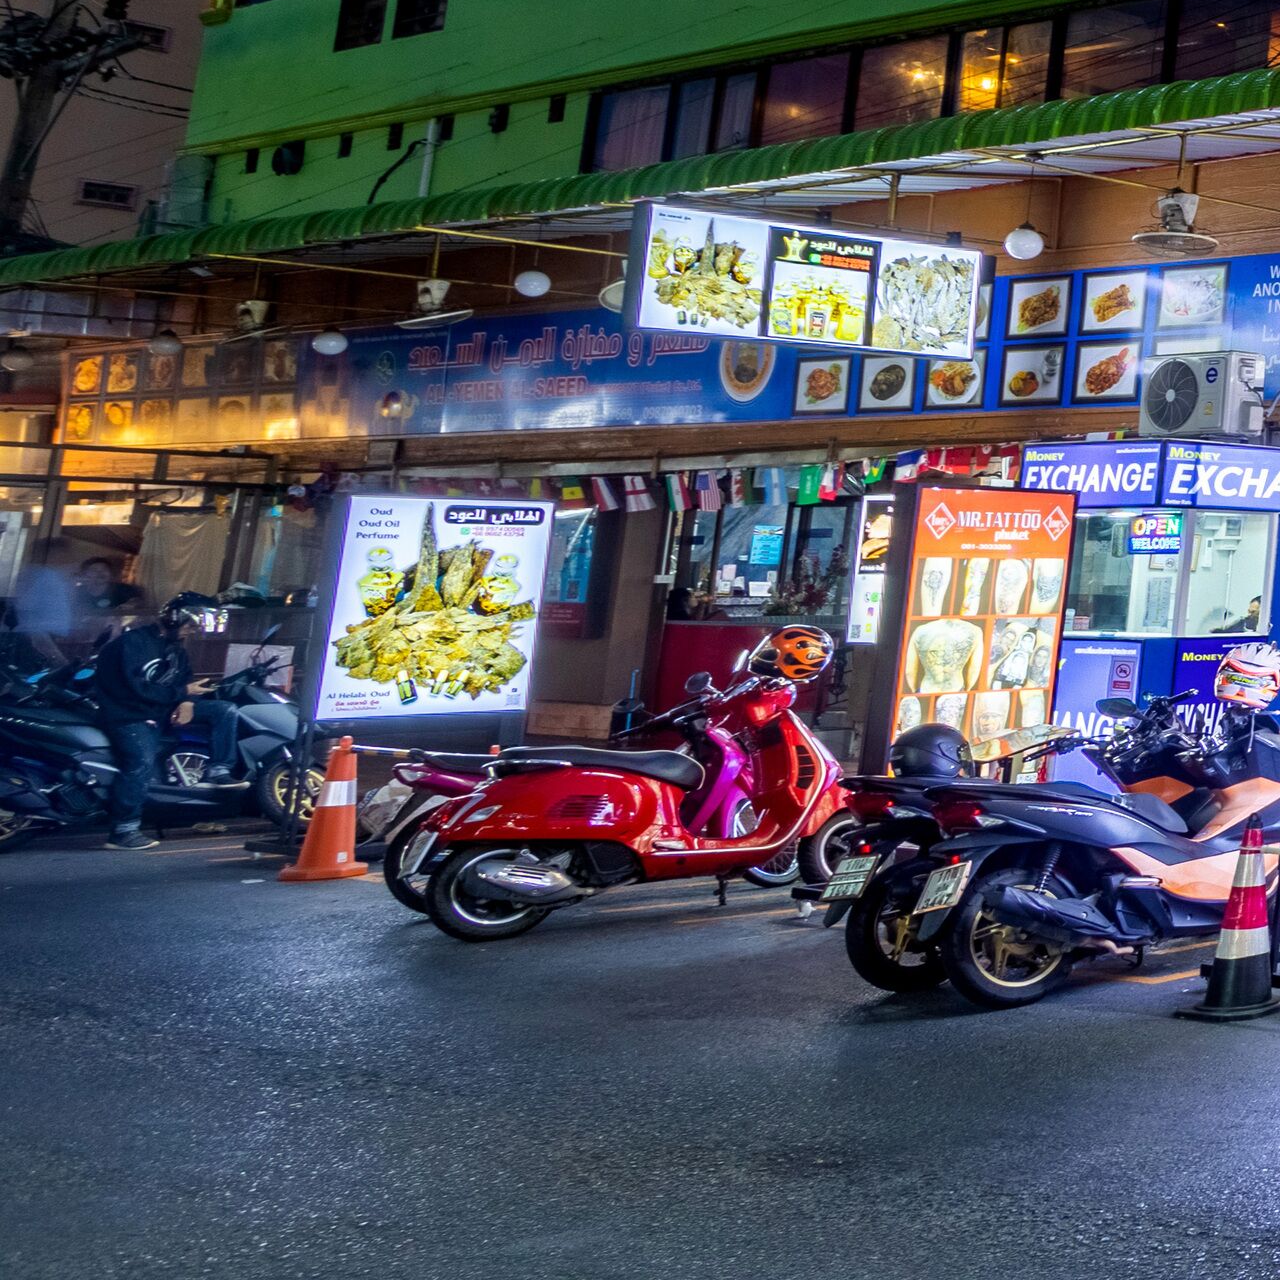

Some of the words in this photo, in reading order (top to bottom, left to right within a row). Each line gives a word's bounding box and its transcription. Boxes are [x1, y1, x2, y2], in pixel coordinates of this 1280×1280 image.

[490, 326, 557, 375] اليمن
[1025, 451, 1065, 462] MONEY
[1170, 447, 1221, 462] MONEY
[1024, 462, 1158, 493] EXCHANGE
[370, 507, 393, 516] Oud
[1133, 518, 1181, 536] OPEN
[356, 531, 400, 540] Perfume
[1131, 537, 1182, 551] WELCOME
[1182, 652, 1224, 662] MONEY
[370, 690, 390, 698] Oud
